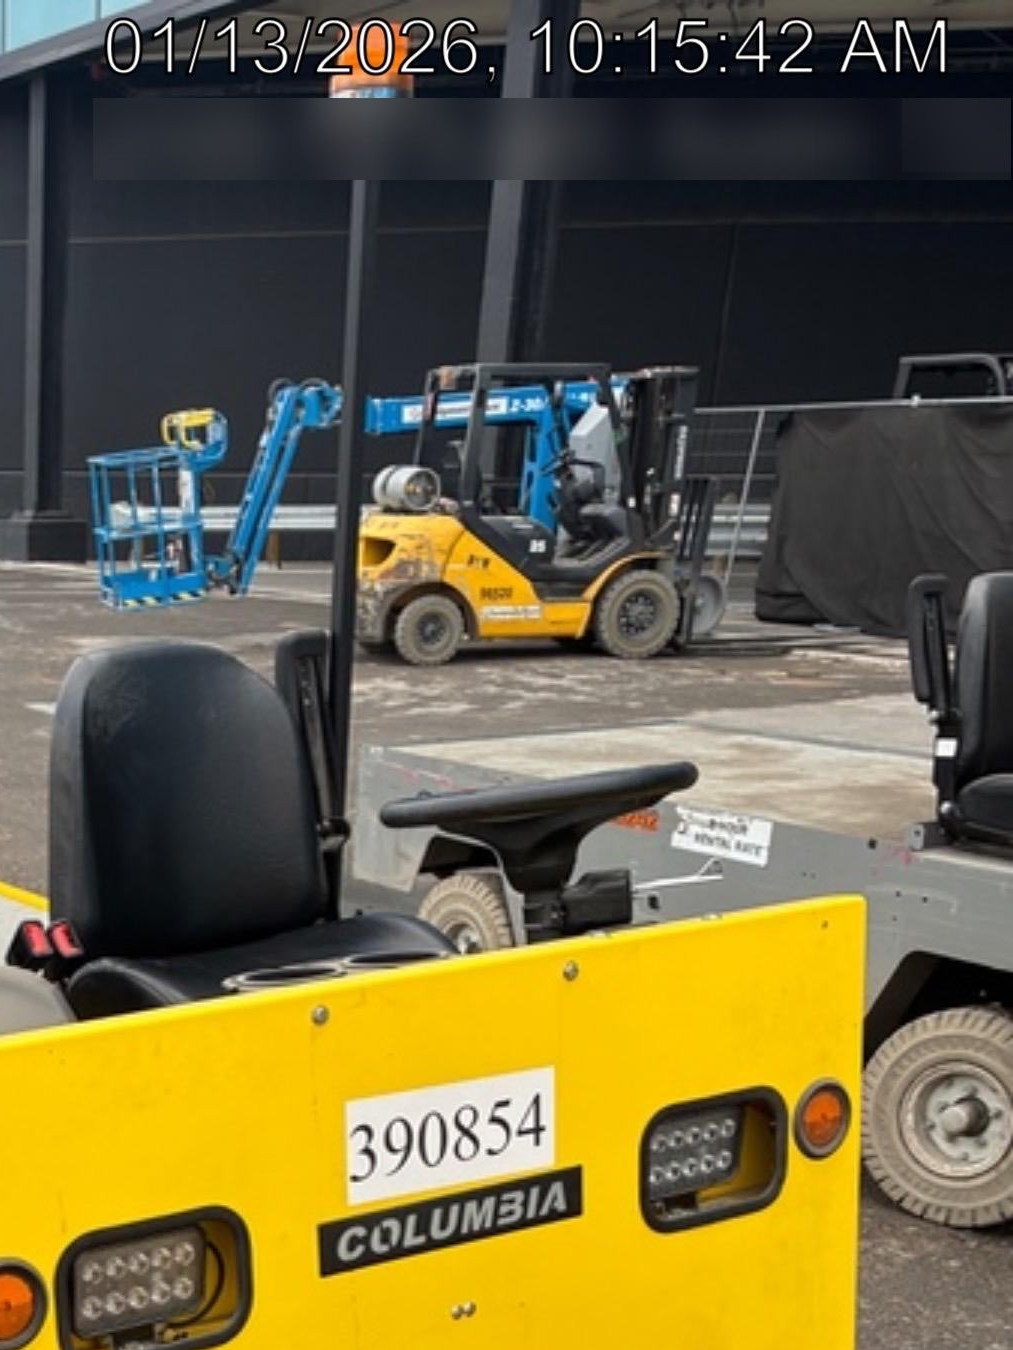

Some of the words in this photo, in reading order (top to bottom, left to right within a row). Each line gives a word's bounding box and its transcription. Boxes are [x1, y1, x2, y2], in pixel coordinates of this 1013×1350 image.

[694, 832, 732, 849] RENTAL
[349, 1091, 547, 1184] 390854
[336, 1180, 569, 1263] COLUMBIA
